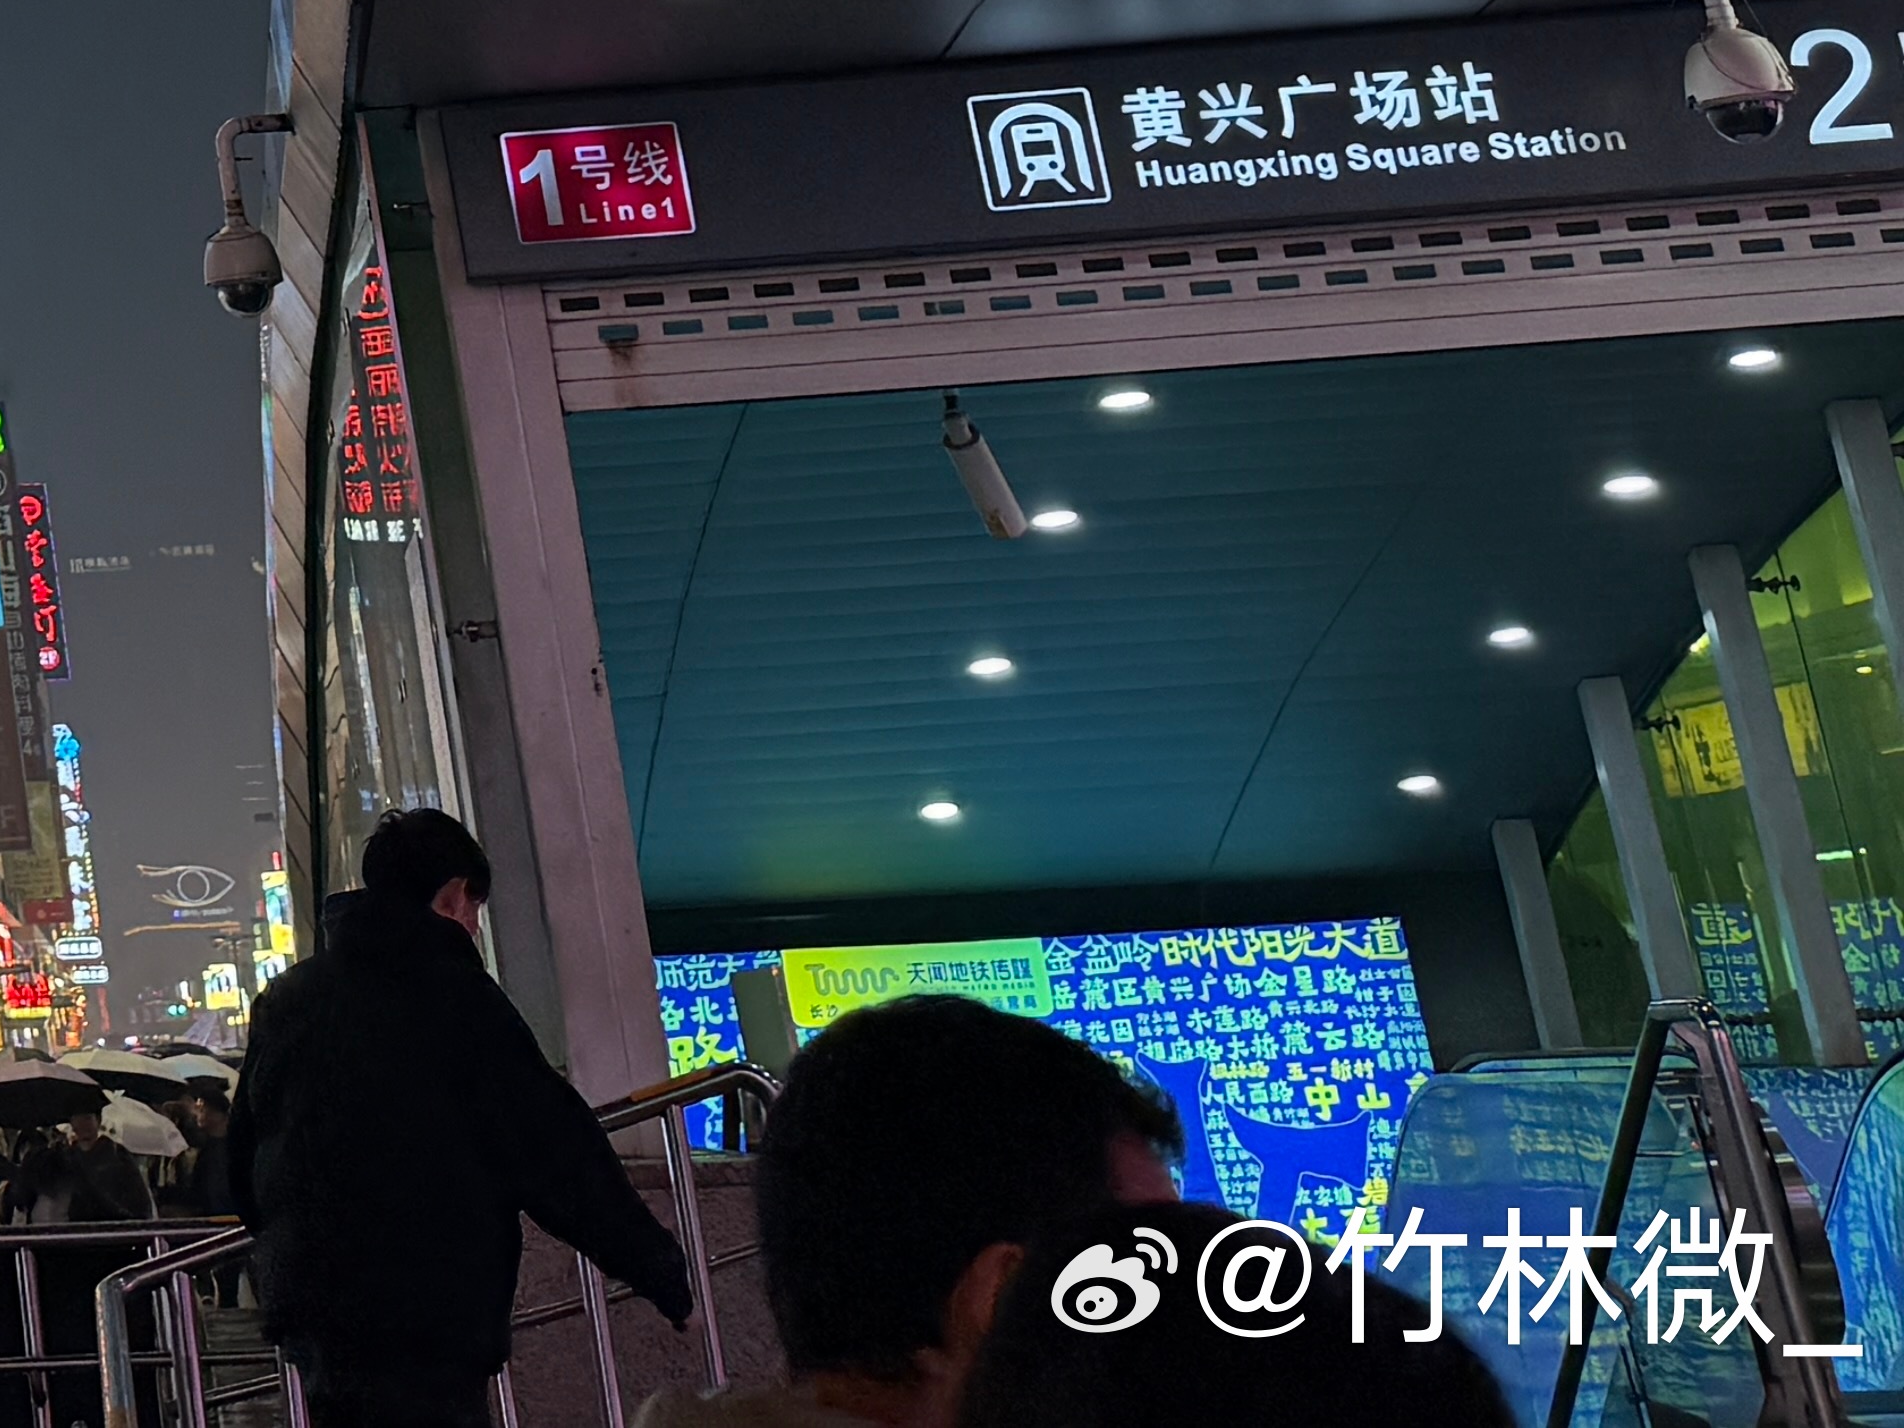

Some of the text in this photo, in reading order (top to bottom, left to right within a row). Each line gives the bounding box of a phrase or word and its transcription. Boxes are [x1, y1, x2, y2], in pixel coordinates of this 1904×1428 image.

[1121, 27, 1904, 152] 黄兴广场站 2
[518, 140, 675, 227] 1号线
[1134, 123, 1628, 190] Huangxing Square Station
[1044, 916, 1409, 977] 金盆岭 时代阳光大道
[1053, 976, 1143, 1012] 岳麓区
[1142, 971, 1253, 1006] 黄兴广场
[1253, 963, 1357, 998] 金星路
